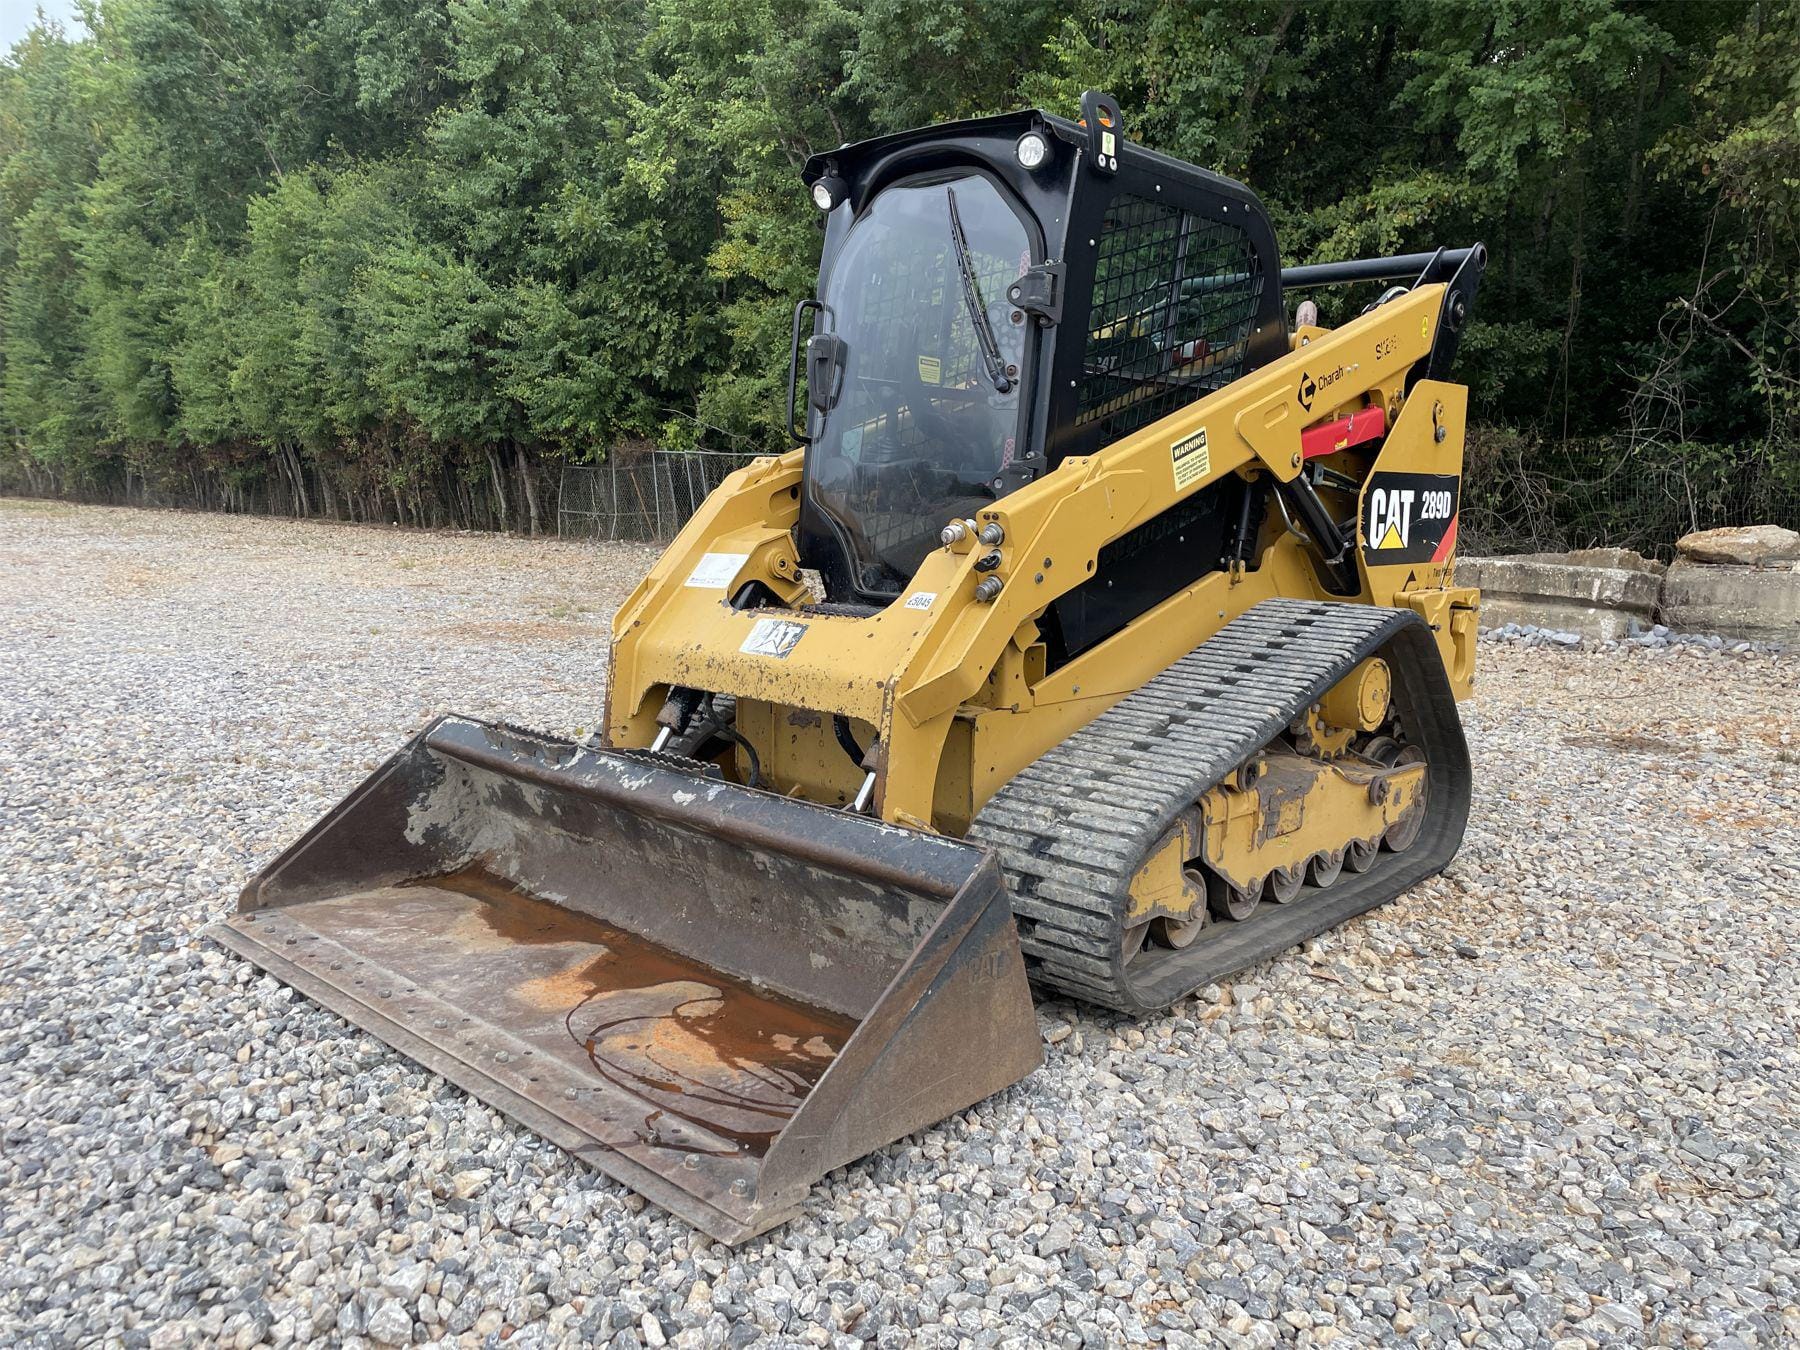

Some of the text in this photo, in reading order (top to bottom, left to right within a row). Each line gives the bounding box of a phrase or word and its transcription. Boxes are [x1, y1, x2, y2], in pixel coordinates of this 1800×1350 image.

[1317, 364, 1344, 391] Charah
[1173, 434, 1205, 459] WARNING
[1369, 487, 1451, 550] CAT 289D
